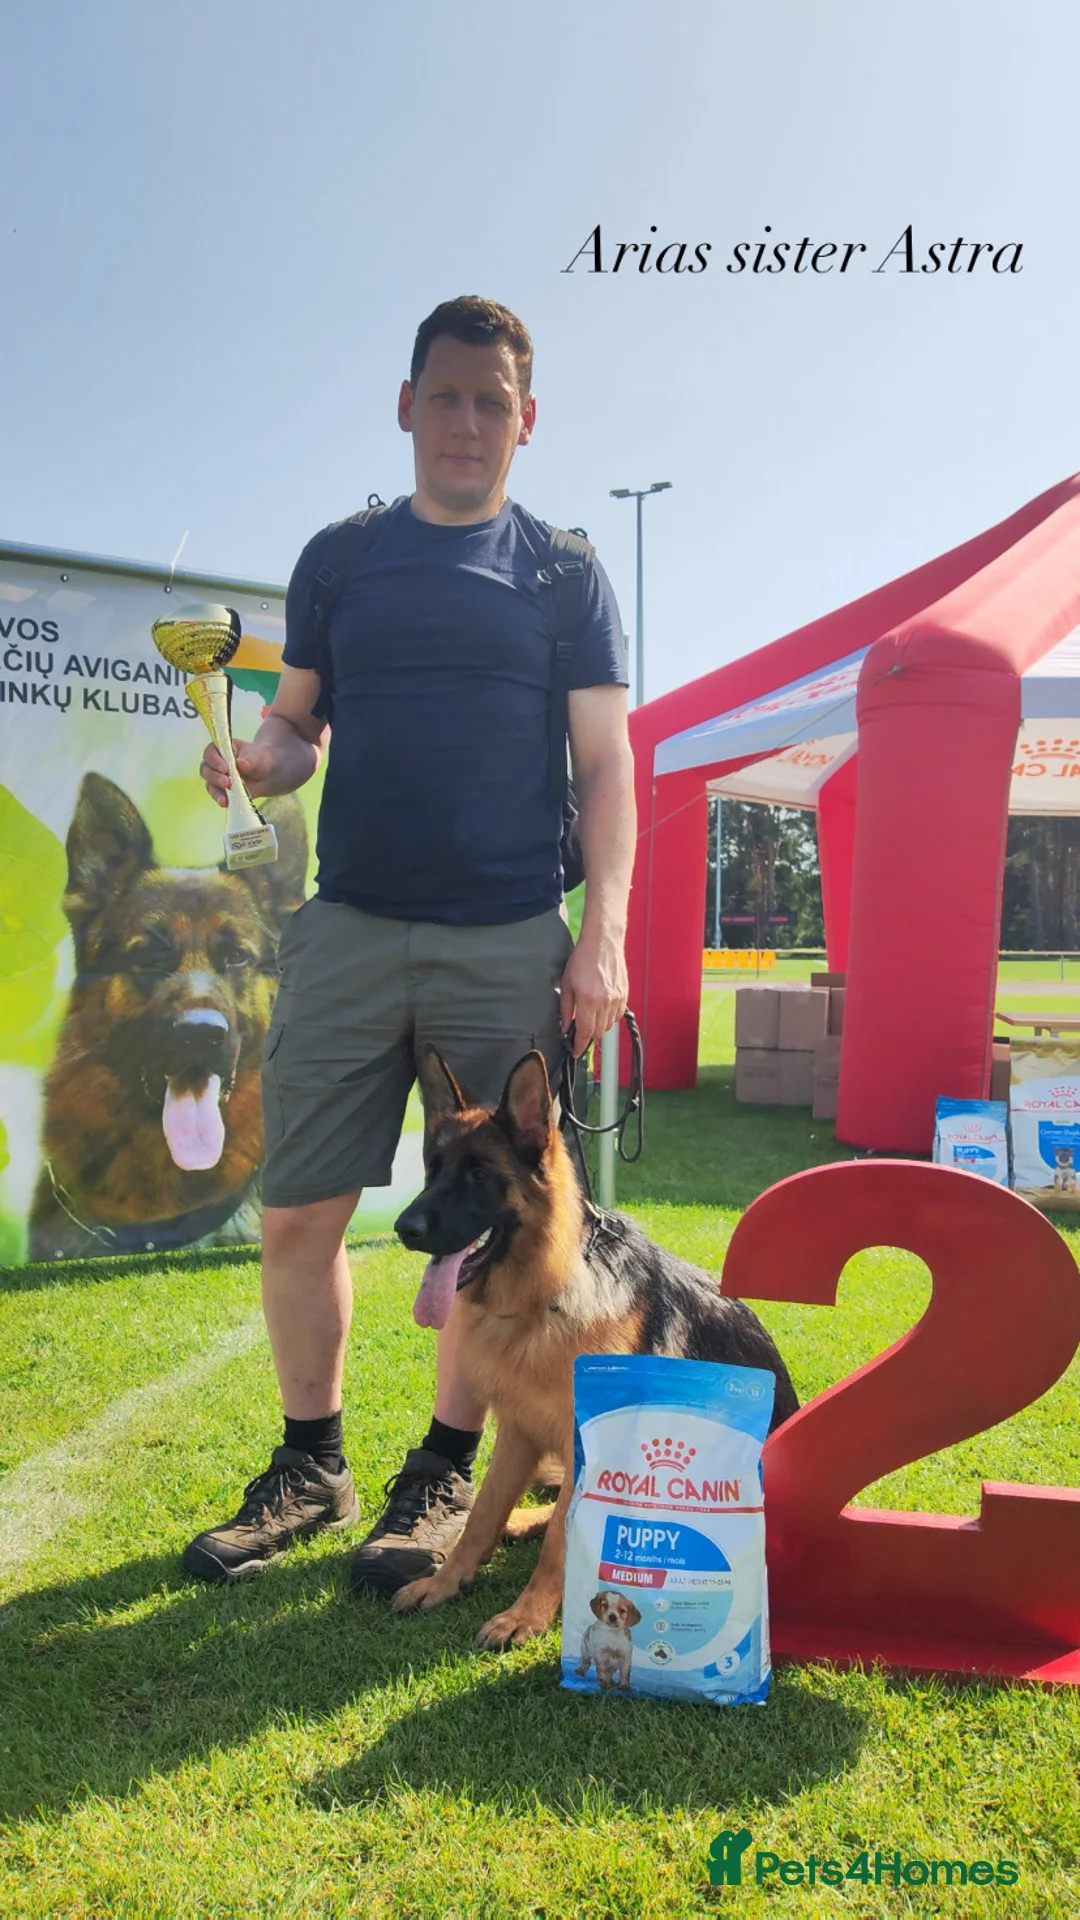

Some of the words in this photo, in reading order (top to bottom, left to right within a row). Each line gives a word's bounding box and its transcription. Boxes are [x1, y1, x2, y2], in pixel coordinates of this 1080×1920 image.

[0, 617, 60, 643] VOS
[0, 643, 54, 679] ČIŲ
[63, 654, 188, 687] AVIGANI
[83, 687, 200, 719] KLUBAS
[1024, 1100, 1062, 1109] ROYAL
[720, 1158, 1080, 1668] 2
[597, 1469, 661, 1498] ROYAL
[667, 1478, 740, 1502] CANIN
[616, 1525, 681, 1550] PUPPY
[614, 1548, 634, 1561] 2-12
[635, 1555, 662, 1564] months
[612, 1568, 653, 1585] MEDIUM
[725, 1656, 734, 1669] 3
